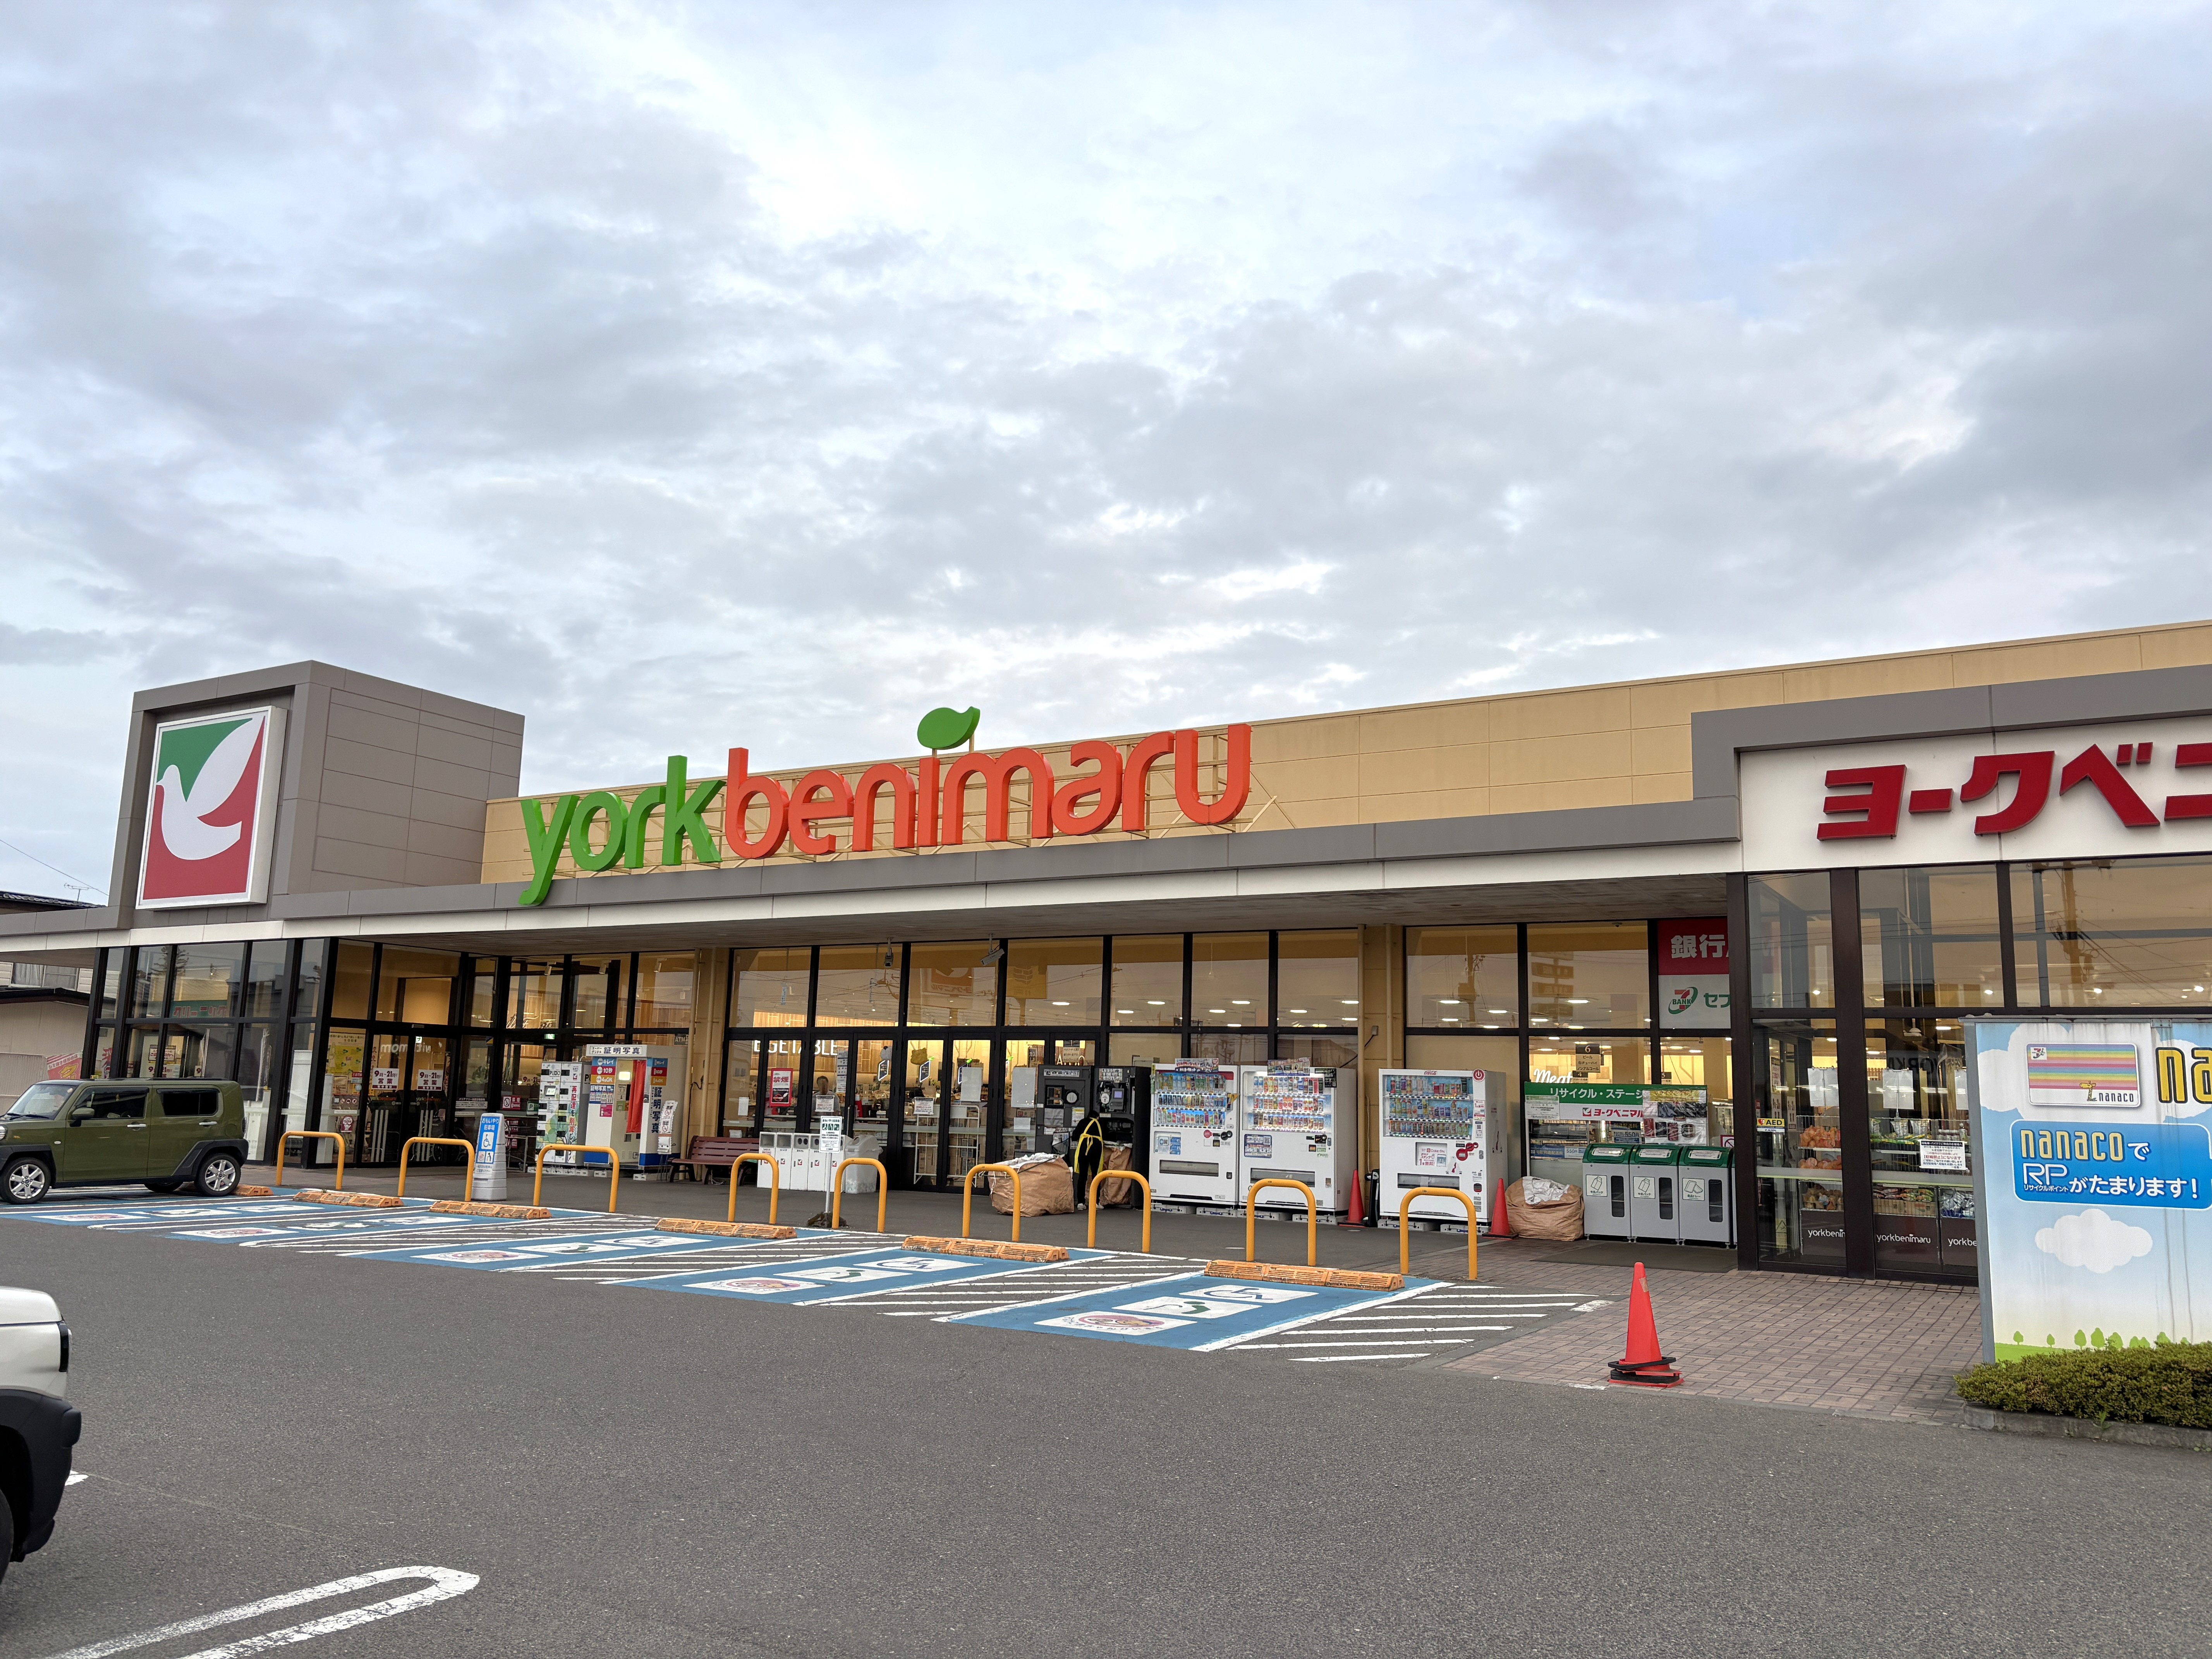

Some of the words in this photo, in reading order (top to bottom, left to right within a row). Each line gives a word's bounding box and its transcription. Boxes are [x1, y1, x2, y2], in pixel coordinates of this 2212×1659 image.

[519, 706, 1252, 905] yorkbenimaru
[1585, 1045, 1591, 1053] 6
[2099, 1092, 2134, 1103] nanaco
[651, 1087, 663, 1133] 証明写真
[2023, 1163, 2068, 1185] RP
[2024, 1184, 2069, 1193] リサイクルポイント
[1876, 1233, 1931, 1243] yorkbenimaru
